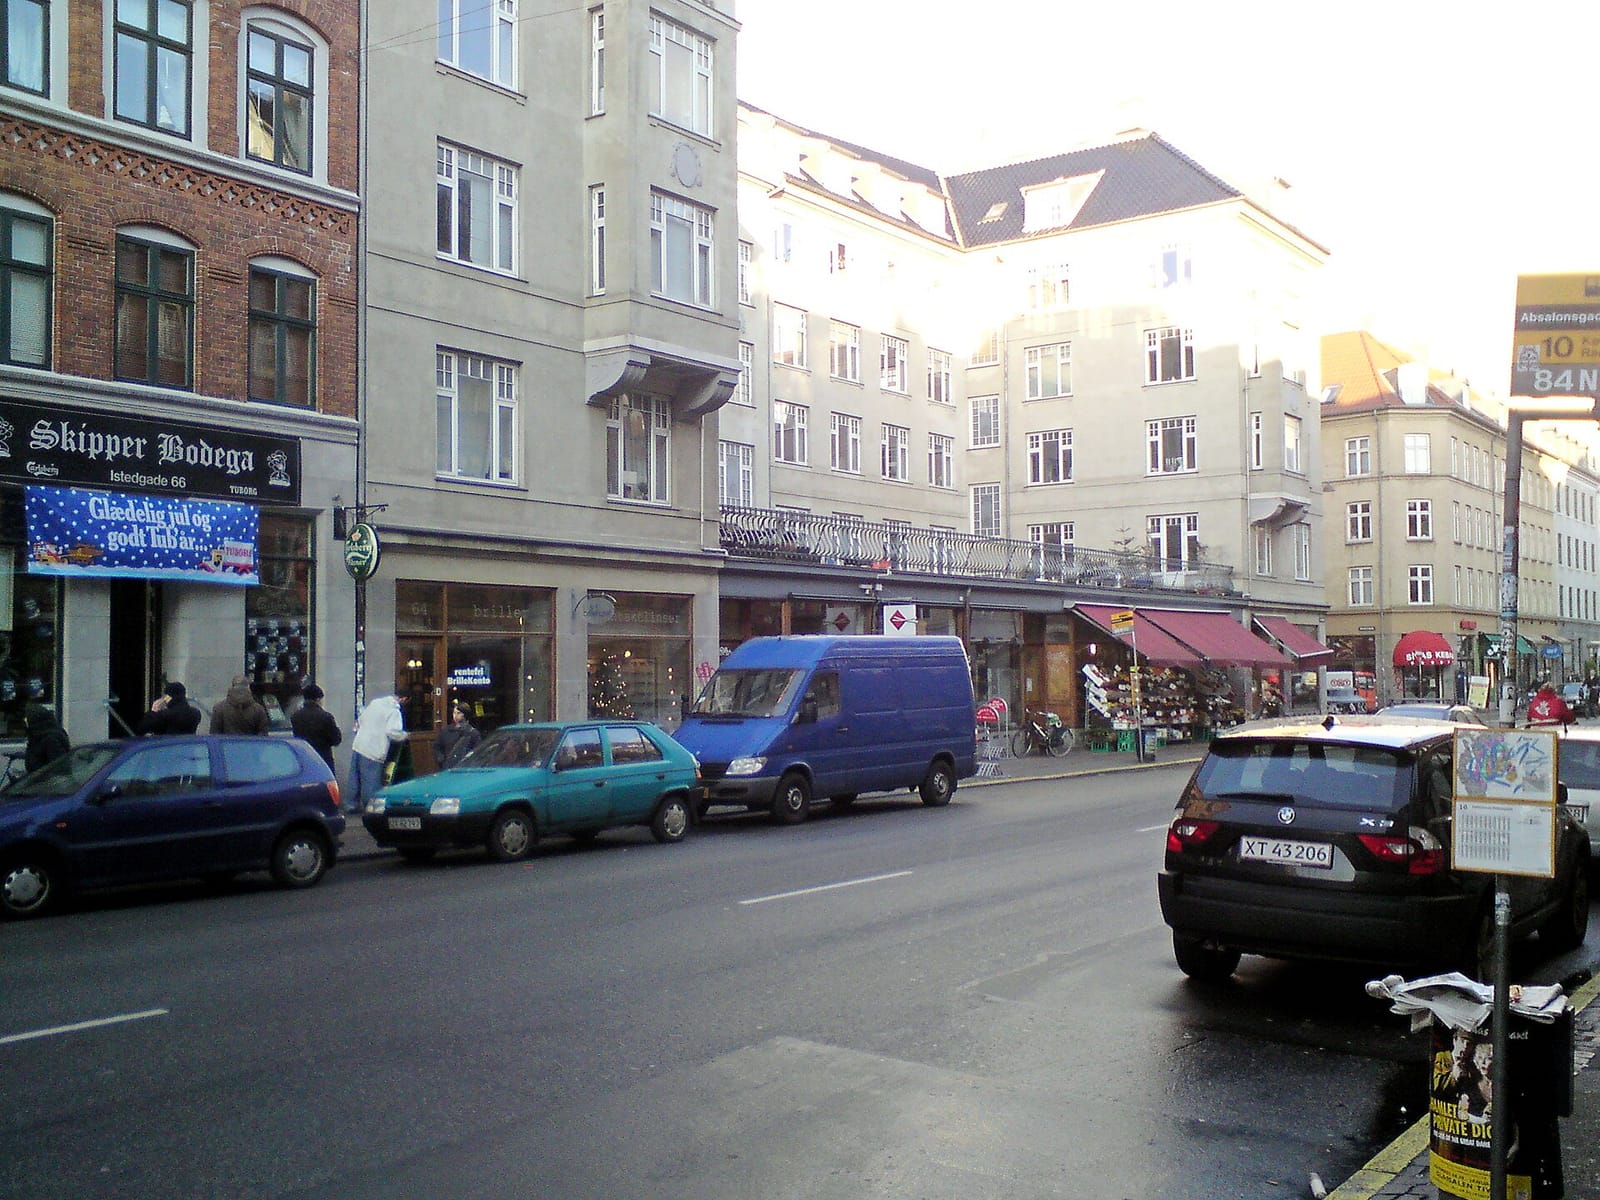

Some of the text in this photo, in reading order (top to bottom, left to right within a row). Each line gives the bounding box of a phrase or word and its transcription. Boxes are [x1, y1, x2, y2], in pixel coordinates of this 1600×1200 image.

[1543, 336, 1574, 358] 10
[29, 420, 255, 475] Skipper Bodega
[26, 461, 59, 476] Carlsberg
[110, 470, 187, 488] Istedgade 66
[230, 485, 258, 496] TUBORG
[88, 496, 210, 532] Glædelig jul og
[107, 524, 147, 551] godt
[473, 604, 529, 618] briller
[454, 667, 484, 676] rentefri
